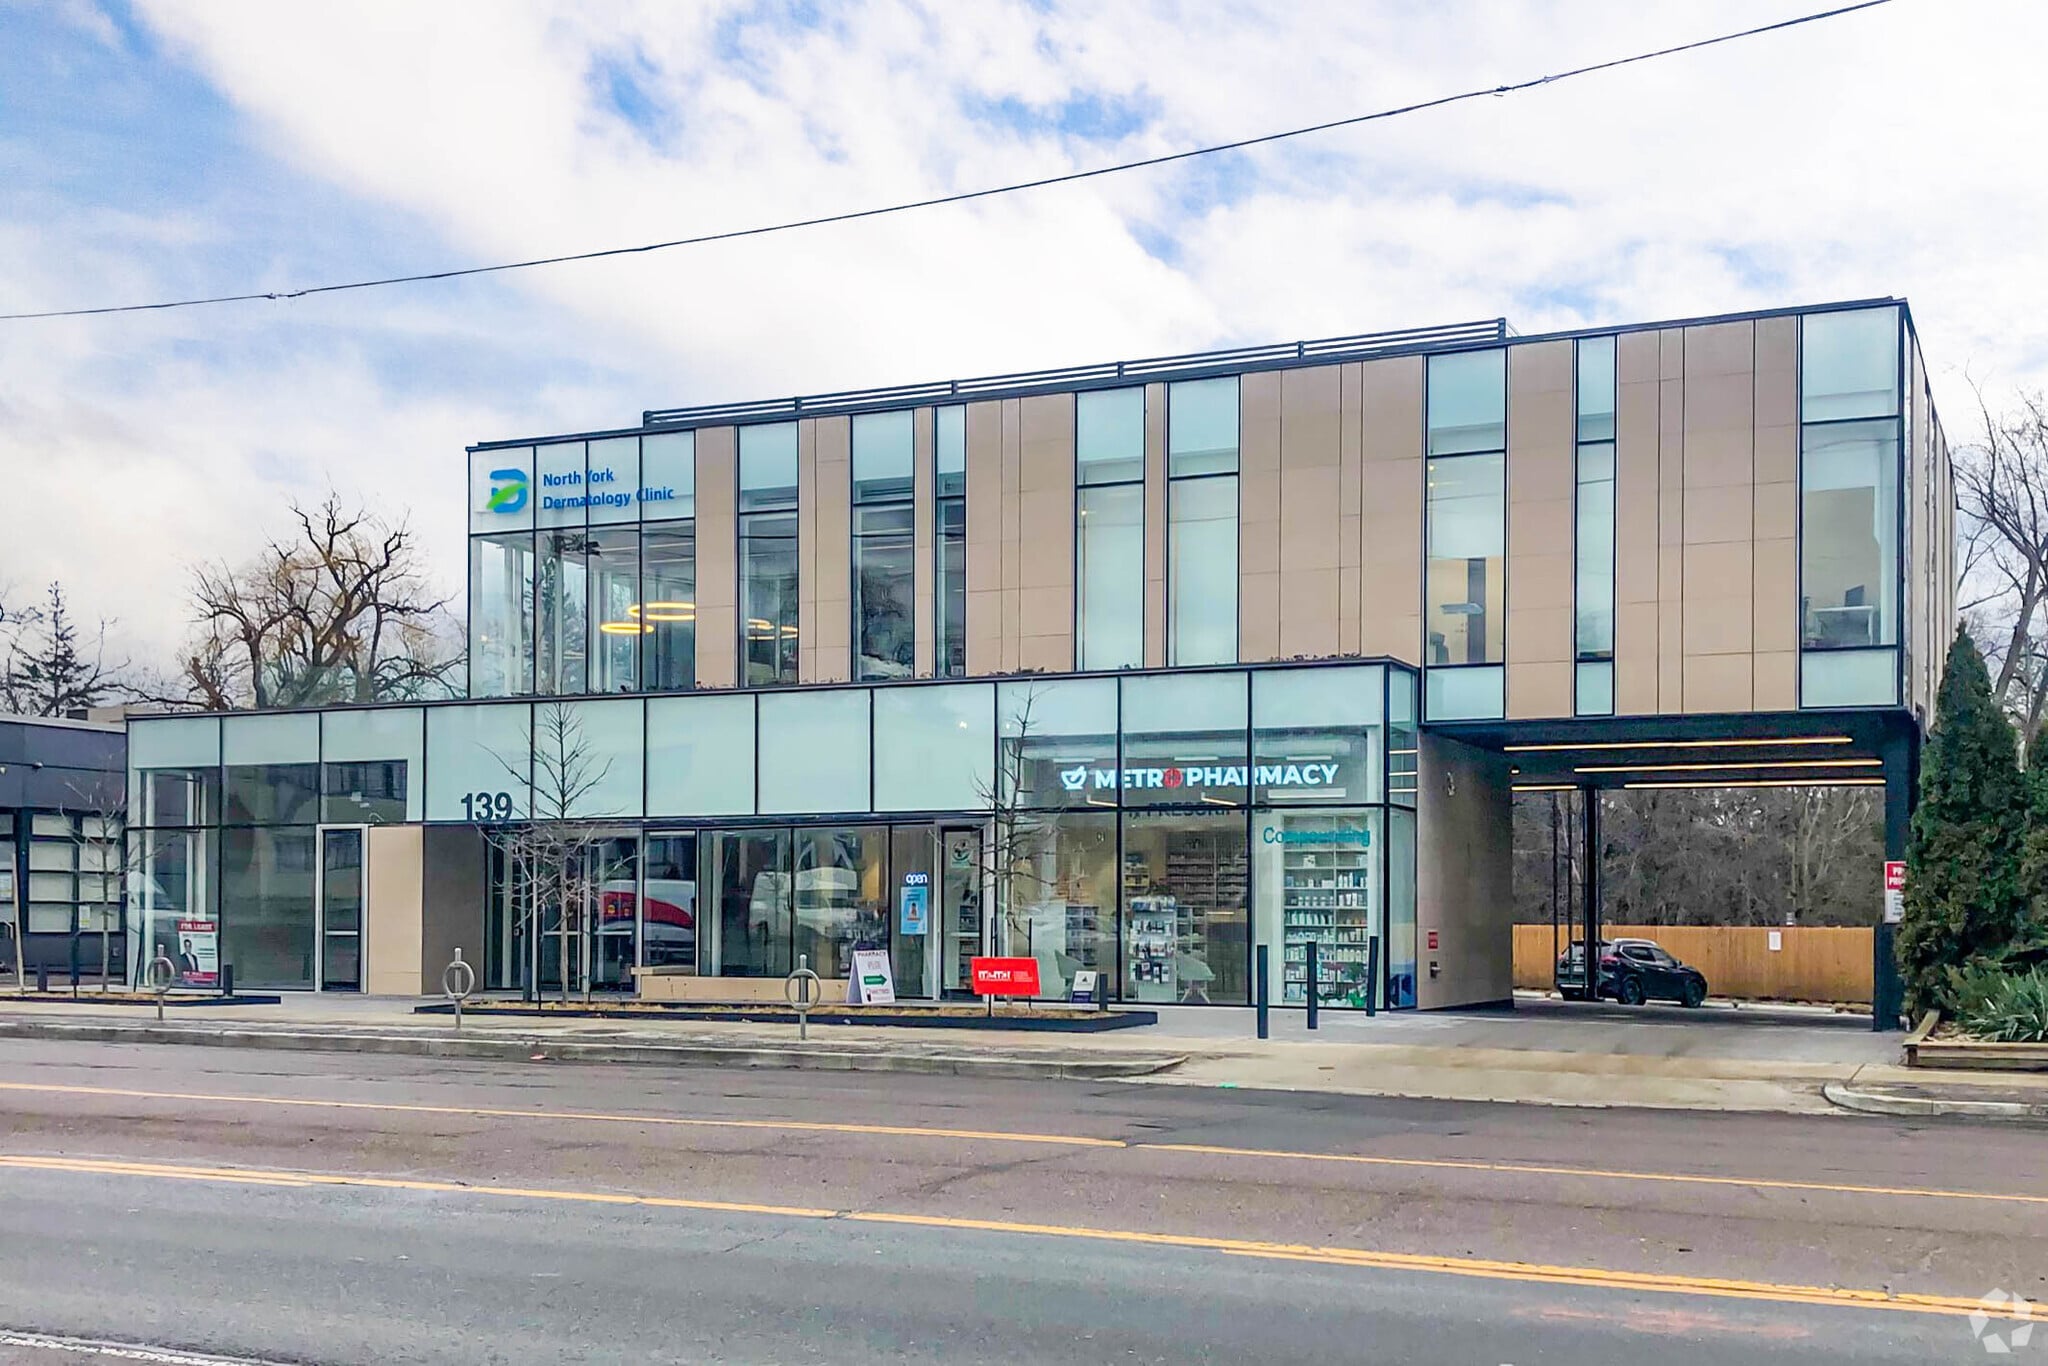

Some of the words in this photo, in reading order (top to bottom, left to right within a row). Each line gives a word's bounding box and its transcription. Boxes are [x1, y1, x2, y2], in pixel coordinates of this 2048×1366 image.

[543, 471, 581, 486] North
[585, 467, 614, 483] York
[543, 491, 631, 510] Dermatology
[636, 486, 675, 502] Clinic
[461, 792, 513, 821] 139
[906, 873, 928, 886] open
